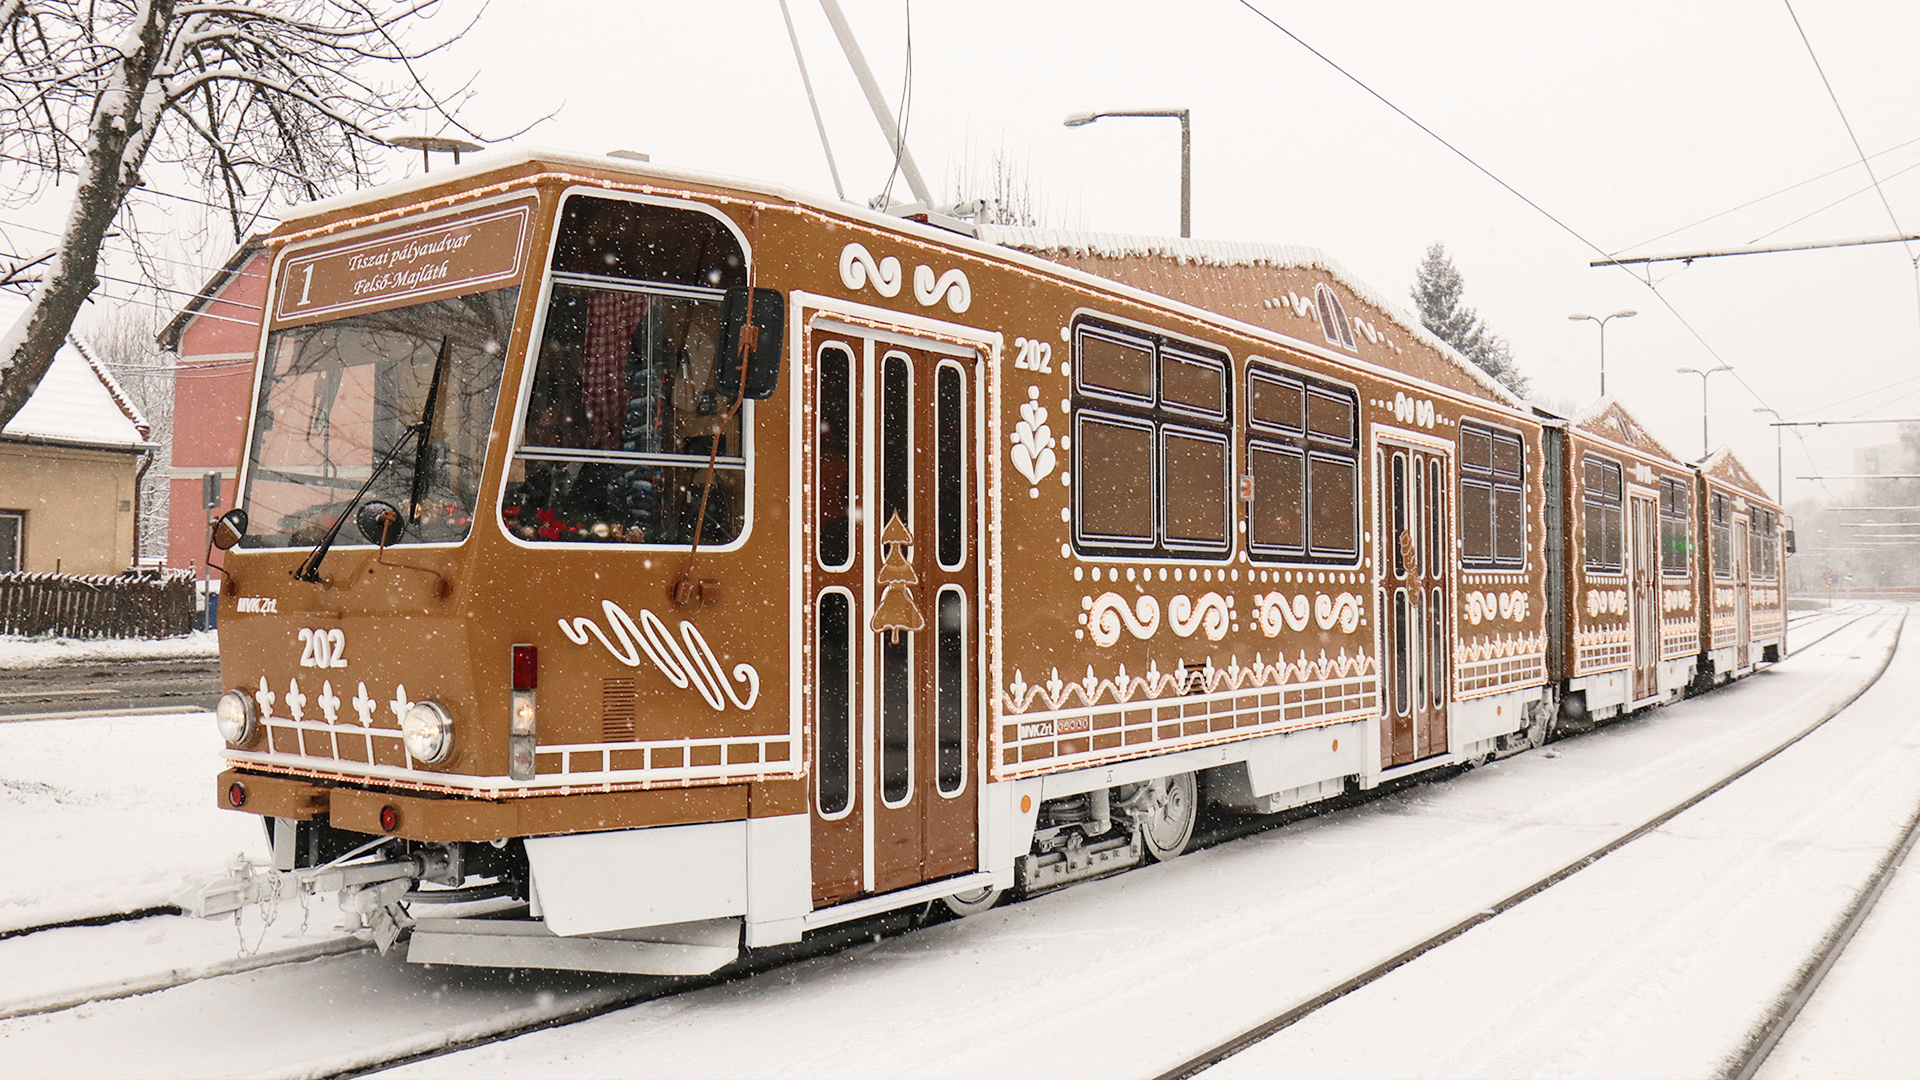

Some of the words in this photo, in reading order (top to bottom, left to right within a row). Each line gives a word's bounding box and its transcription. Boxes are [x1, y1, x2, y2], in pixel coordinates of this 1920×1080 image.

[348, 247, 391, 271] Tiszai
[388, 232, 472, 268] pályaudvar
[297, 264, 314, 306] 1
[353, 259, 450, 295] Felső-Majláth
[1014, 336, 1052, 374] 202
[298, 627, 348, 669] 202
